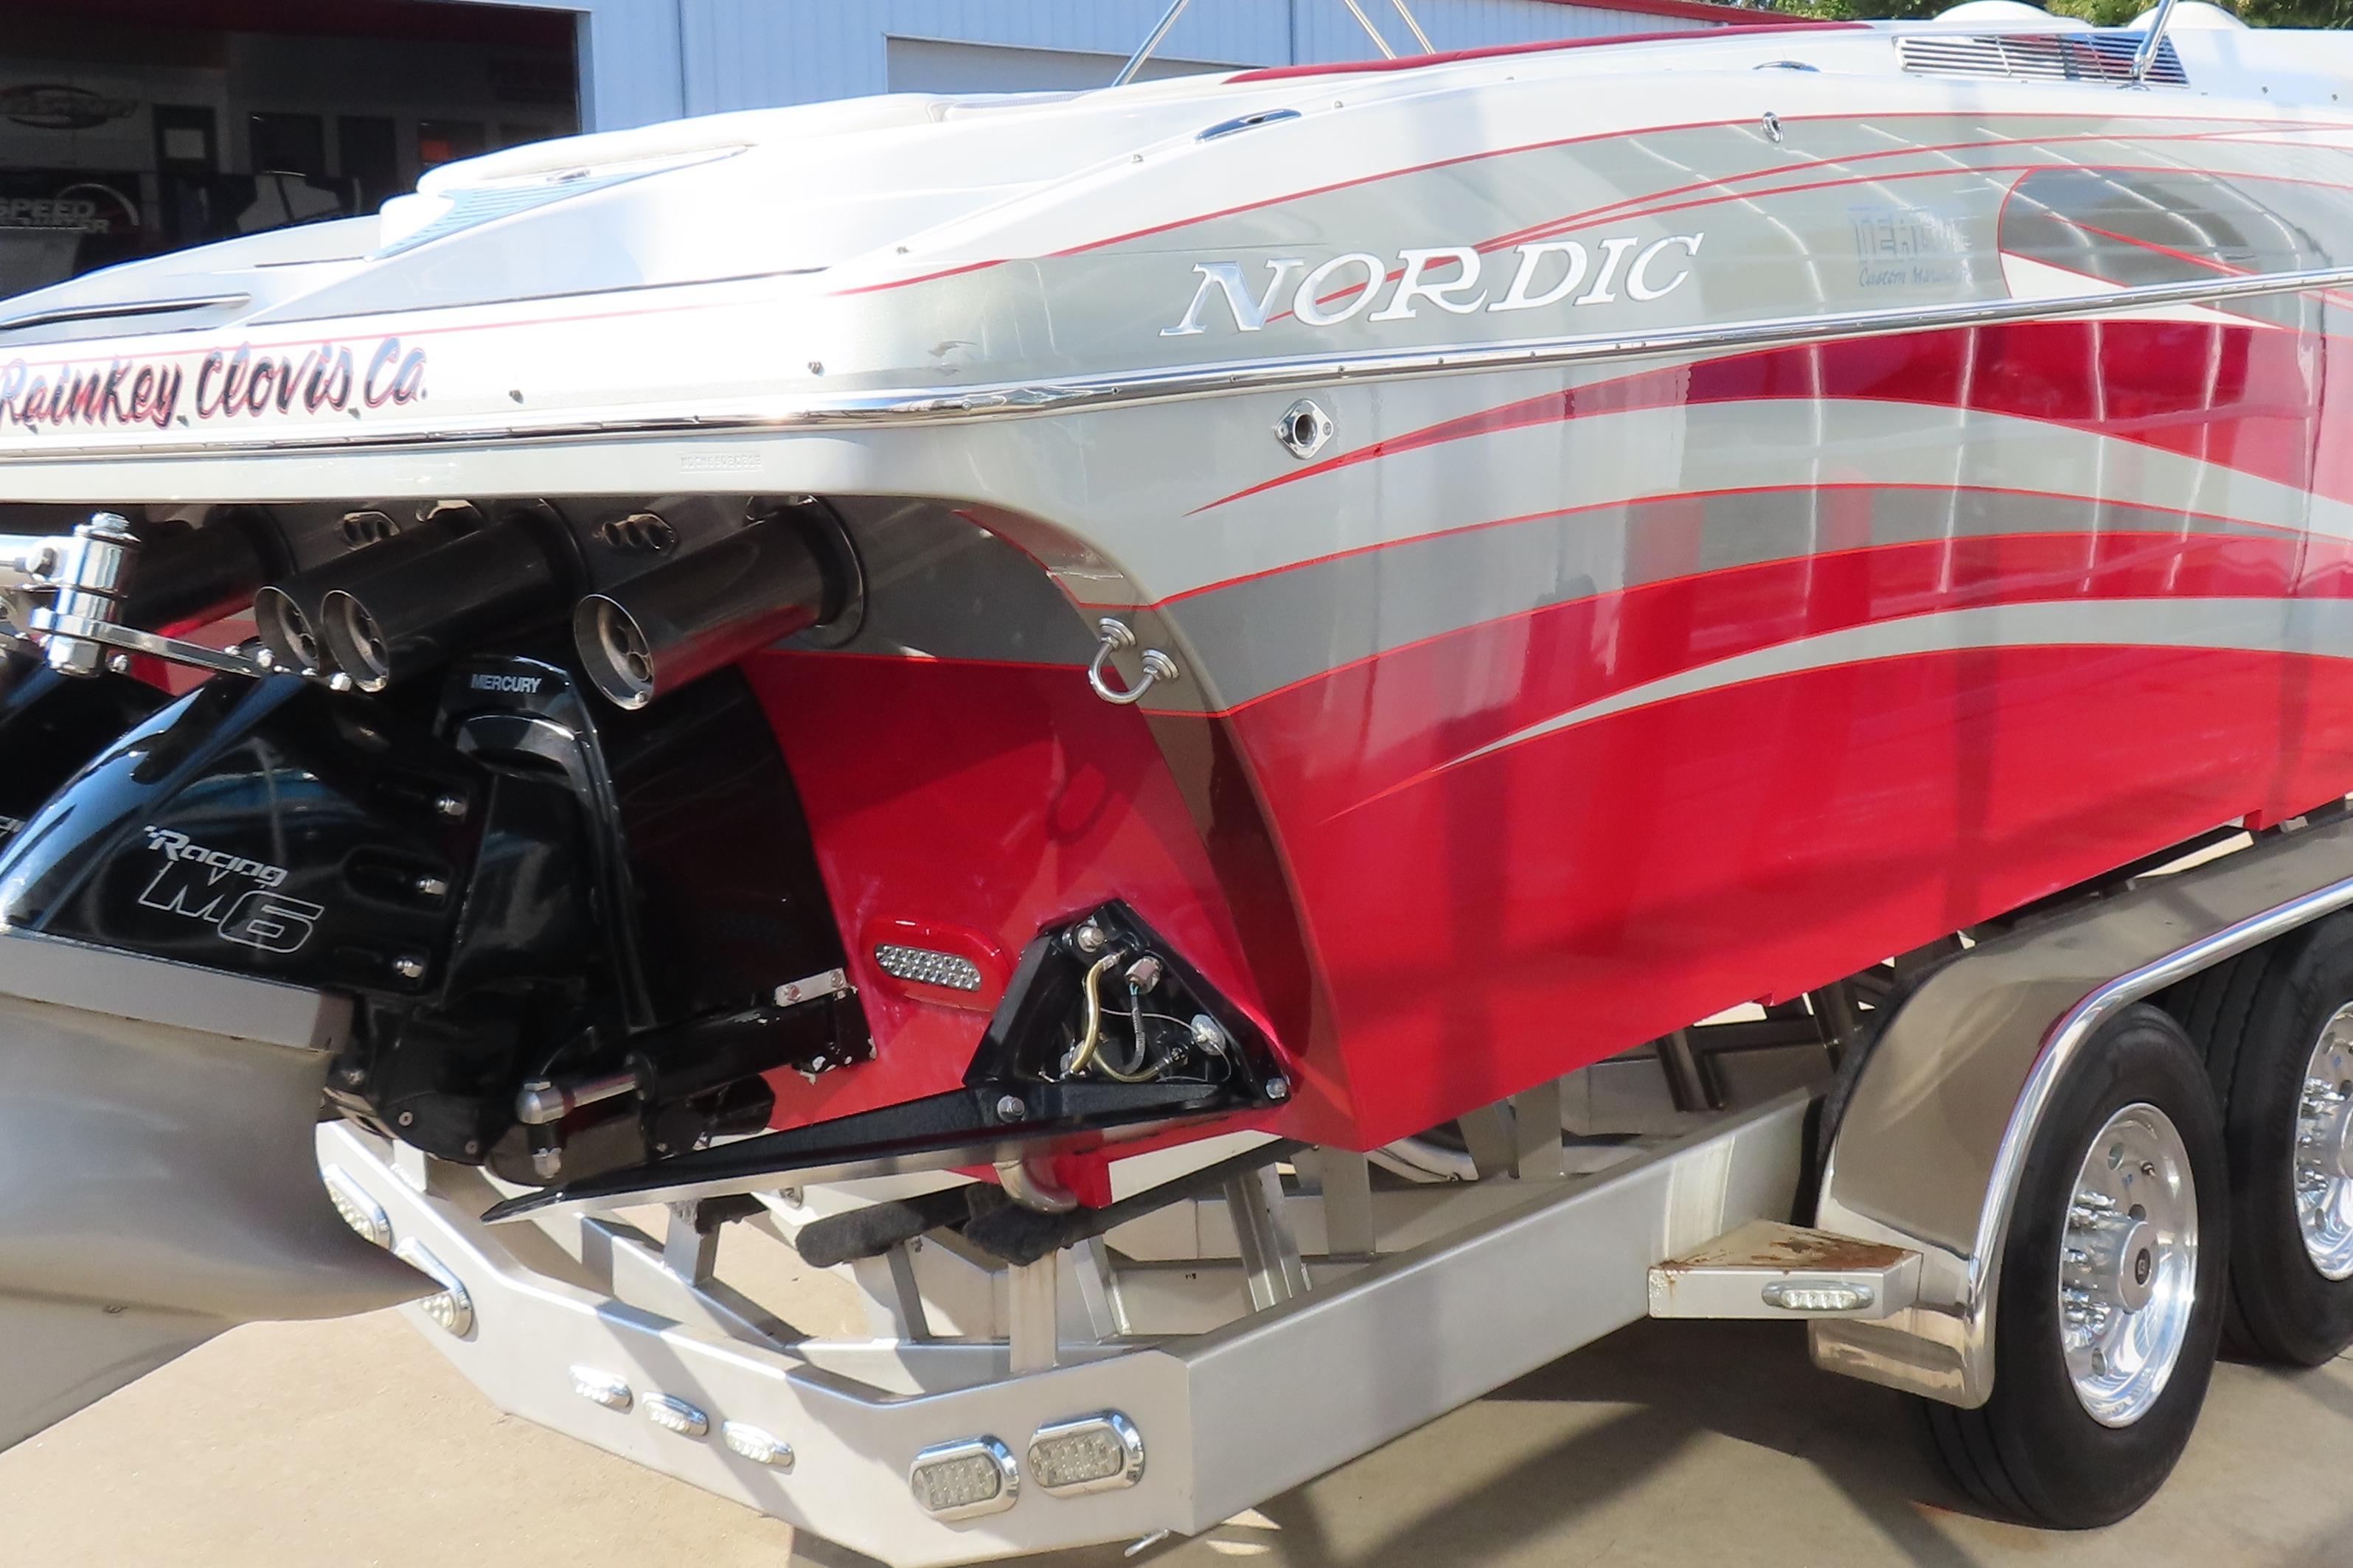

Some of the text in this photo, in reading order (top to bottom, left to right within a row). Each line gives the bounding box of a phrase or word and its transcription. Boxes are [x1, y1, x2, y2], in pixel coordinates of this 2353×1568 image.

[1158, 231, 1705, 337] NORDIC
[1859, 266, 1906, 288] Custom
[470, 673, 543, 694] MERCURY
[144, 825, 288, 888] Racing
[138, 860, 325, 953] M6
